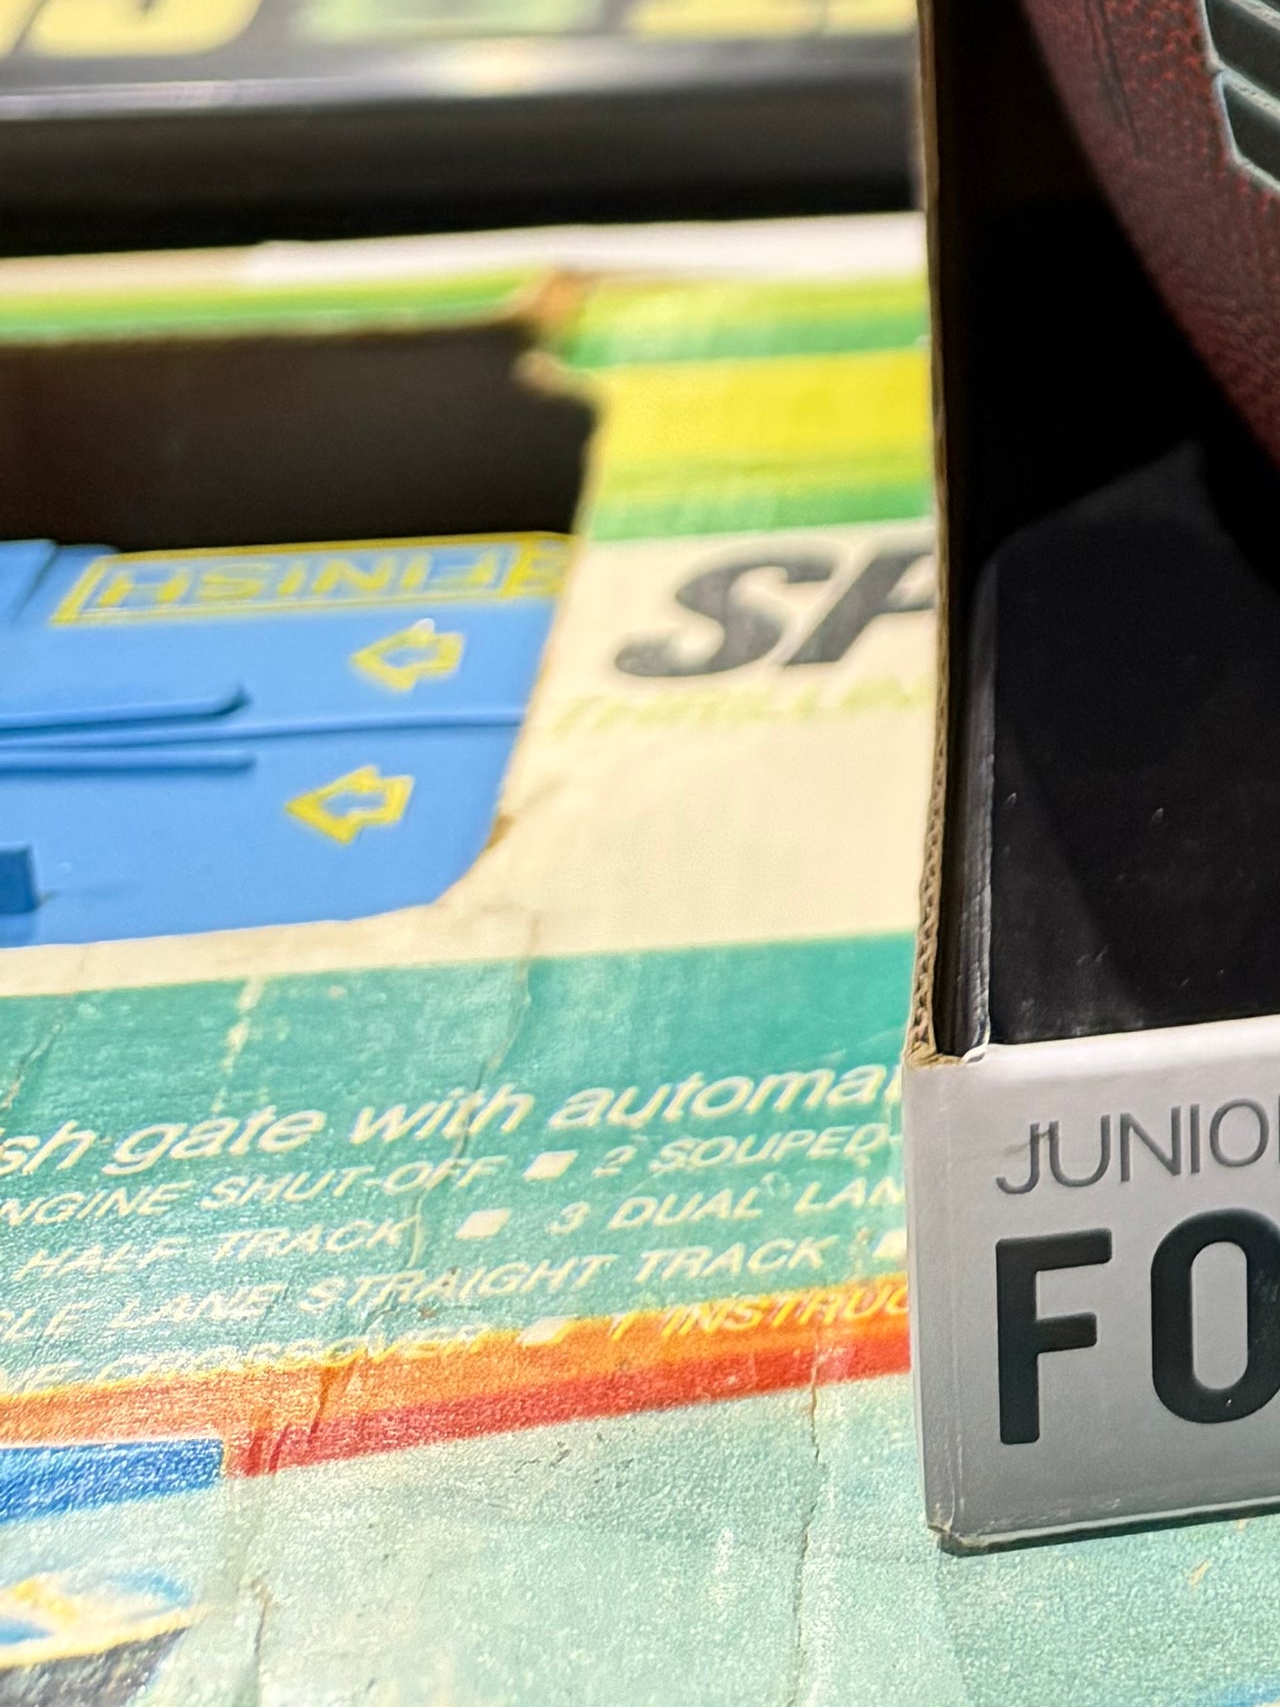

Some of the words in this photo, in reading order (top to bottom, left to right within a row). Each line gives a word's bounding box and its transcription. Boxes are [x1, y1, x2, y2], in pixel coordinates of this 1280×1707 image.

[0, 1119, 96, 1176] sh
[102, 1104, 326, 1176] gate
[349, 1083, 535, 1145] with
[200, 1154, 507, 1210] SHUT-OFF
[591, 1145, 638, 1178] 2
[11, 1239, 190, 1282] HALF
[212, 1214, 412, 1264] TRACK
[546, 1200, 591, 1236] 3
[607, 1187, 764, 1231] DUAL
[106, 1282, 288, 1330] LANE
[299, 1253, 618, 1314] STRAIGHT
[634, 1234, 839, 1284] TRACK
